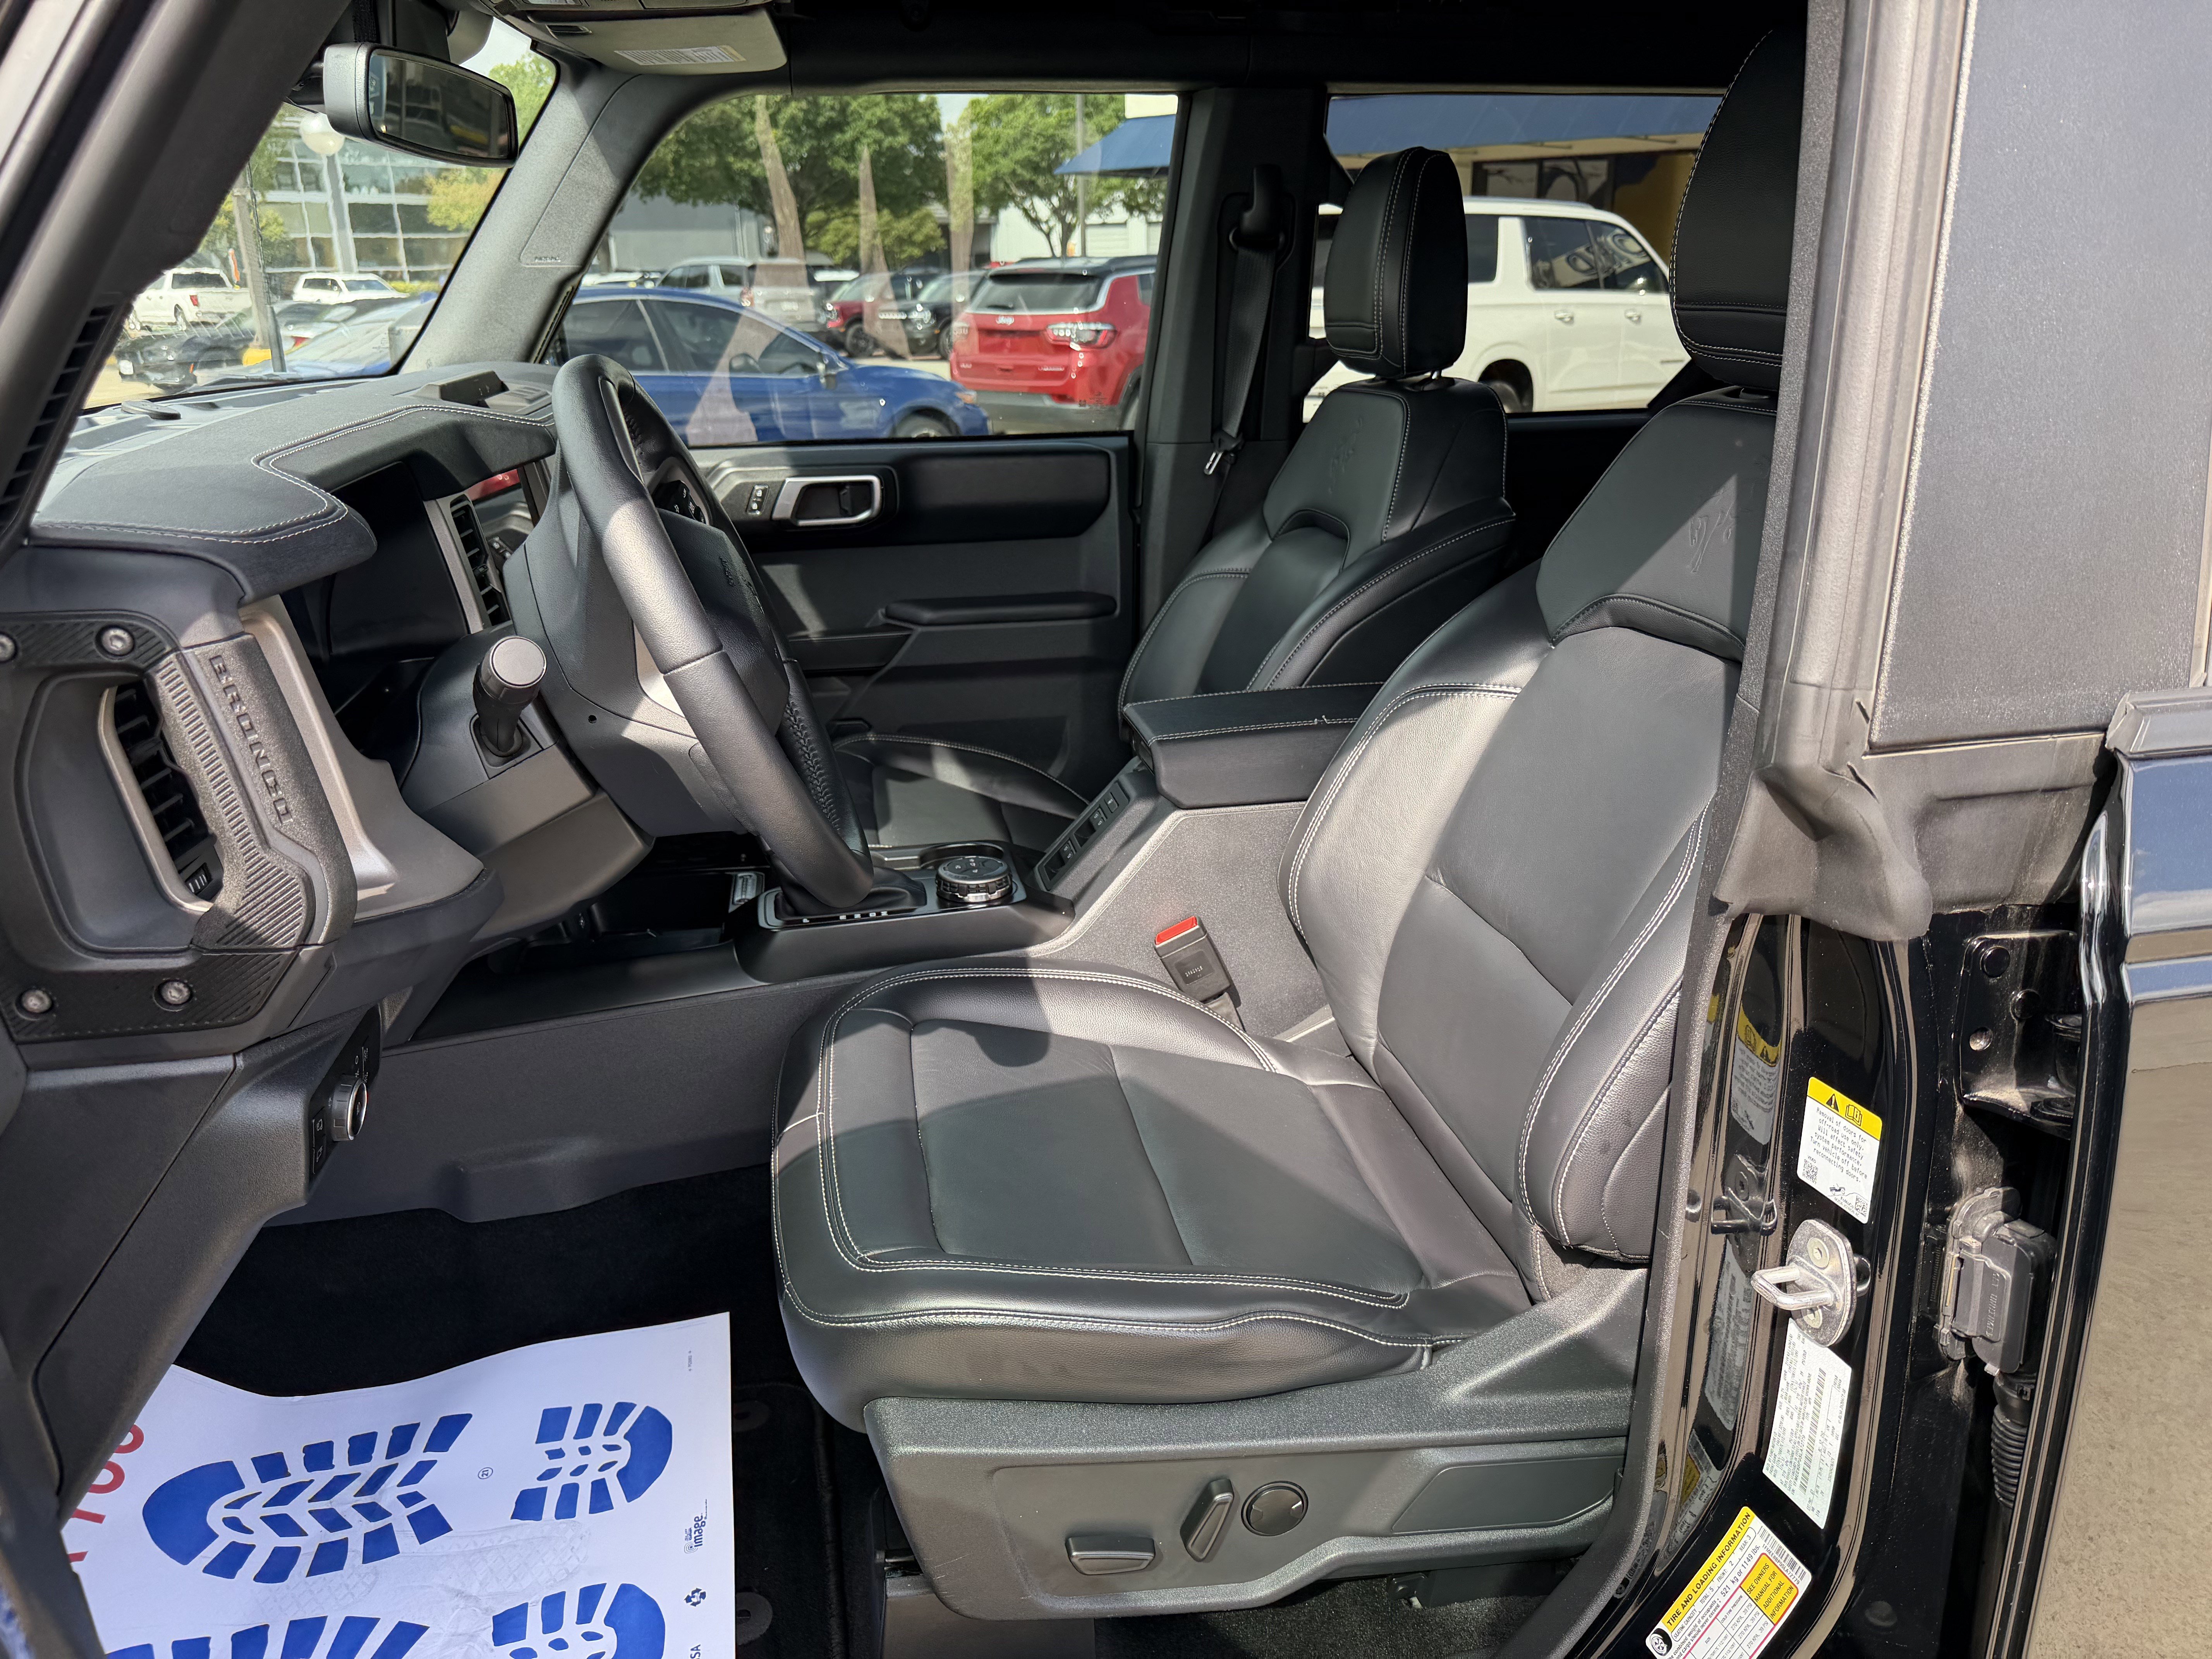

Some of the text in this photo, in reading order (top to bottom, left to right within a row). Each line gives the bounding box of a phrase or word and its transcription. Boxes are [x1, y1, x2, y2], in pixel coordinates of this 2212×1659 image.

[208, 654, 293, 824] BRONCO
[1814, 1130, 1830, 1147] system
[1816, 1106, 1867, 1145] Removal of doors for
[1817, 1124, 1863, 1161] Will affect safety
[1819, 1116, 1864, 1153] off-road use only.
[1810, 1135, 1867, 1180] Turn vehicle off before
[1813, 1146, 1861, 1183] reconnecting doors.
[694, 1515, 706, 1547] image
[1666, 1511, 1753, 1627] TIRE AND LOADING INFORMATION
[1719, 1542, 1761, 1597] 521 kg or 1149 lbs.
[1746, 1562, 1771, 1594] SEE OWNERS
[1753, 1570, 1778, 1603] MANUAL FOR
[1673, 1623, 1686, 1639] SEATING
[1683, 1607, 1698, 1626] CAPACITY
[1716, 1568, 1728, 1583] FRONT:
[1738, 1539, 1749, 1552] REAR:
[1761, 1579, 1786, 1610] ADDITIONAL
[1767, 1585, 1795, 1620] INFORMATION
[1672, 1635, 1688, 1656] combined
[1686, 1622, 1699, 1638] weight
[1700, 1598, 1717, 1621] occupants
[1720, 1614, 1728, 1624] COLD
[1731, 1594, 1743, 1610] PRESSURE
[1681, 1640, 1692, 1654] cargo
[1689, 1627, 1701, 1642] should
[1699, 1617, 1710, 1630] never
[1707, 1602, 1720, 1619] exceed
[1758, 1626, 1765, 1634] 39
[690, 1644, 701, 1659] SA
